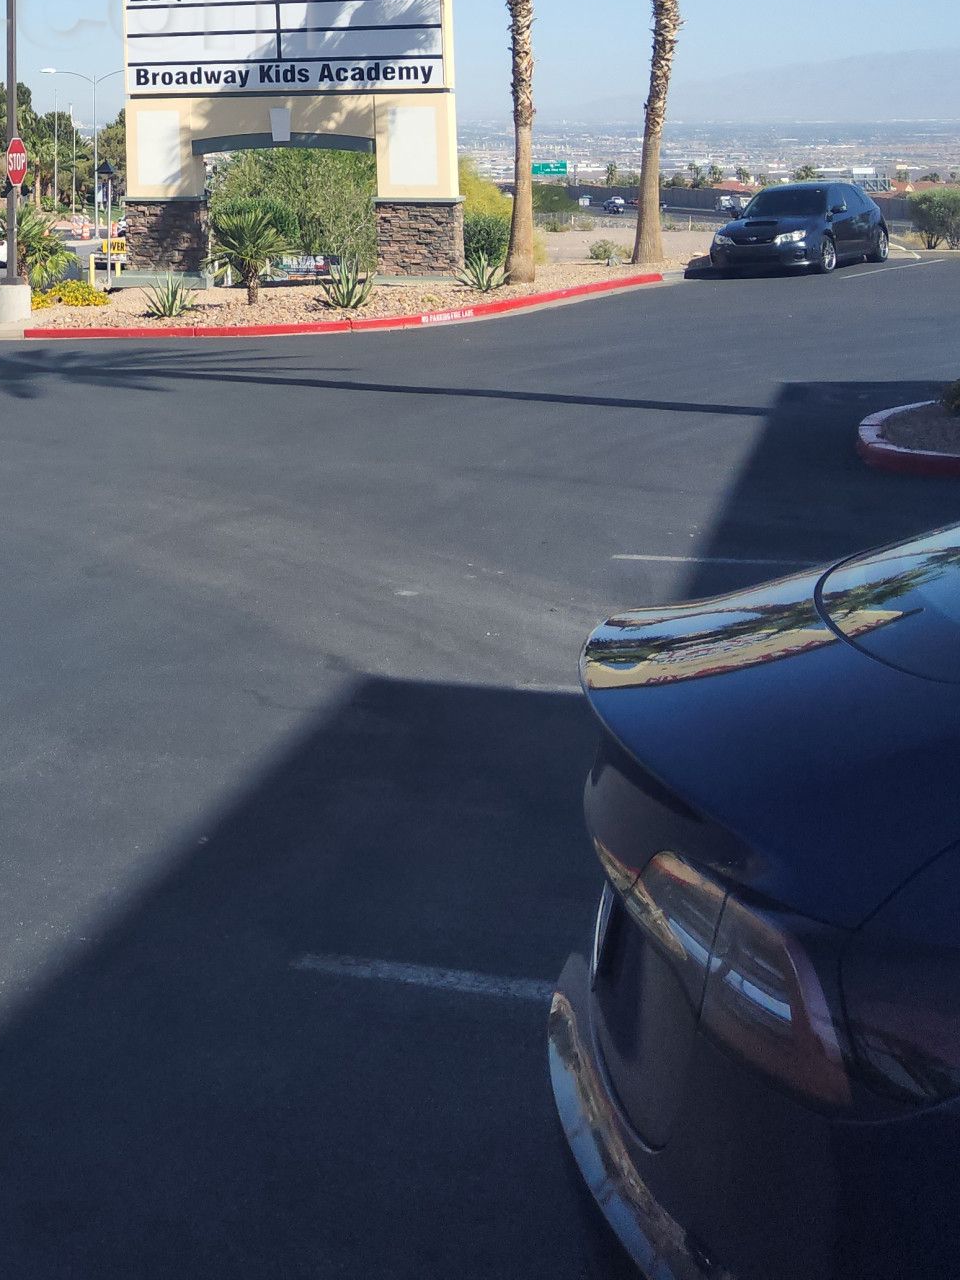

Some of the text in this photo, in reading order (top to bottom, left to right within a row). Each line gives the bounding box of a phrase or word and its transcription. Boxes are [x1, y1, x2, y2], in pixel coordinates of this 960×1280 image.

[136, 62, 434, 88] Broadway Kids Academy
[9, 153, 26, 171] STOP
